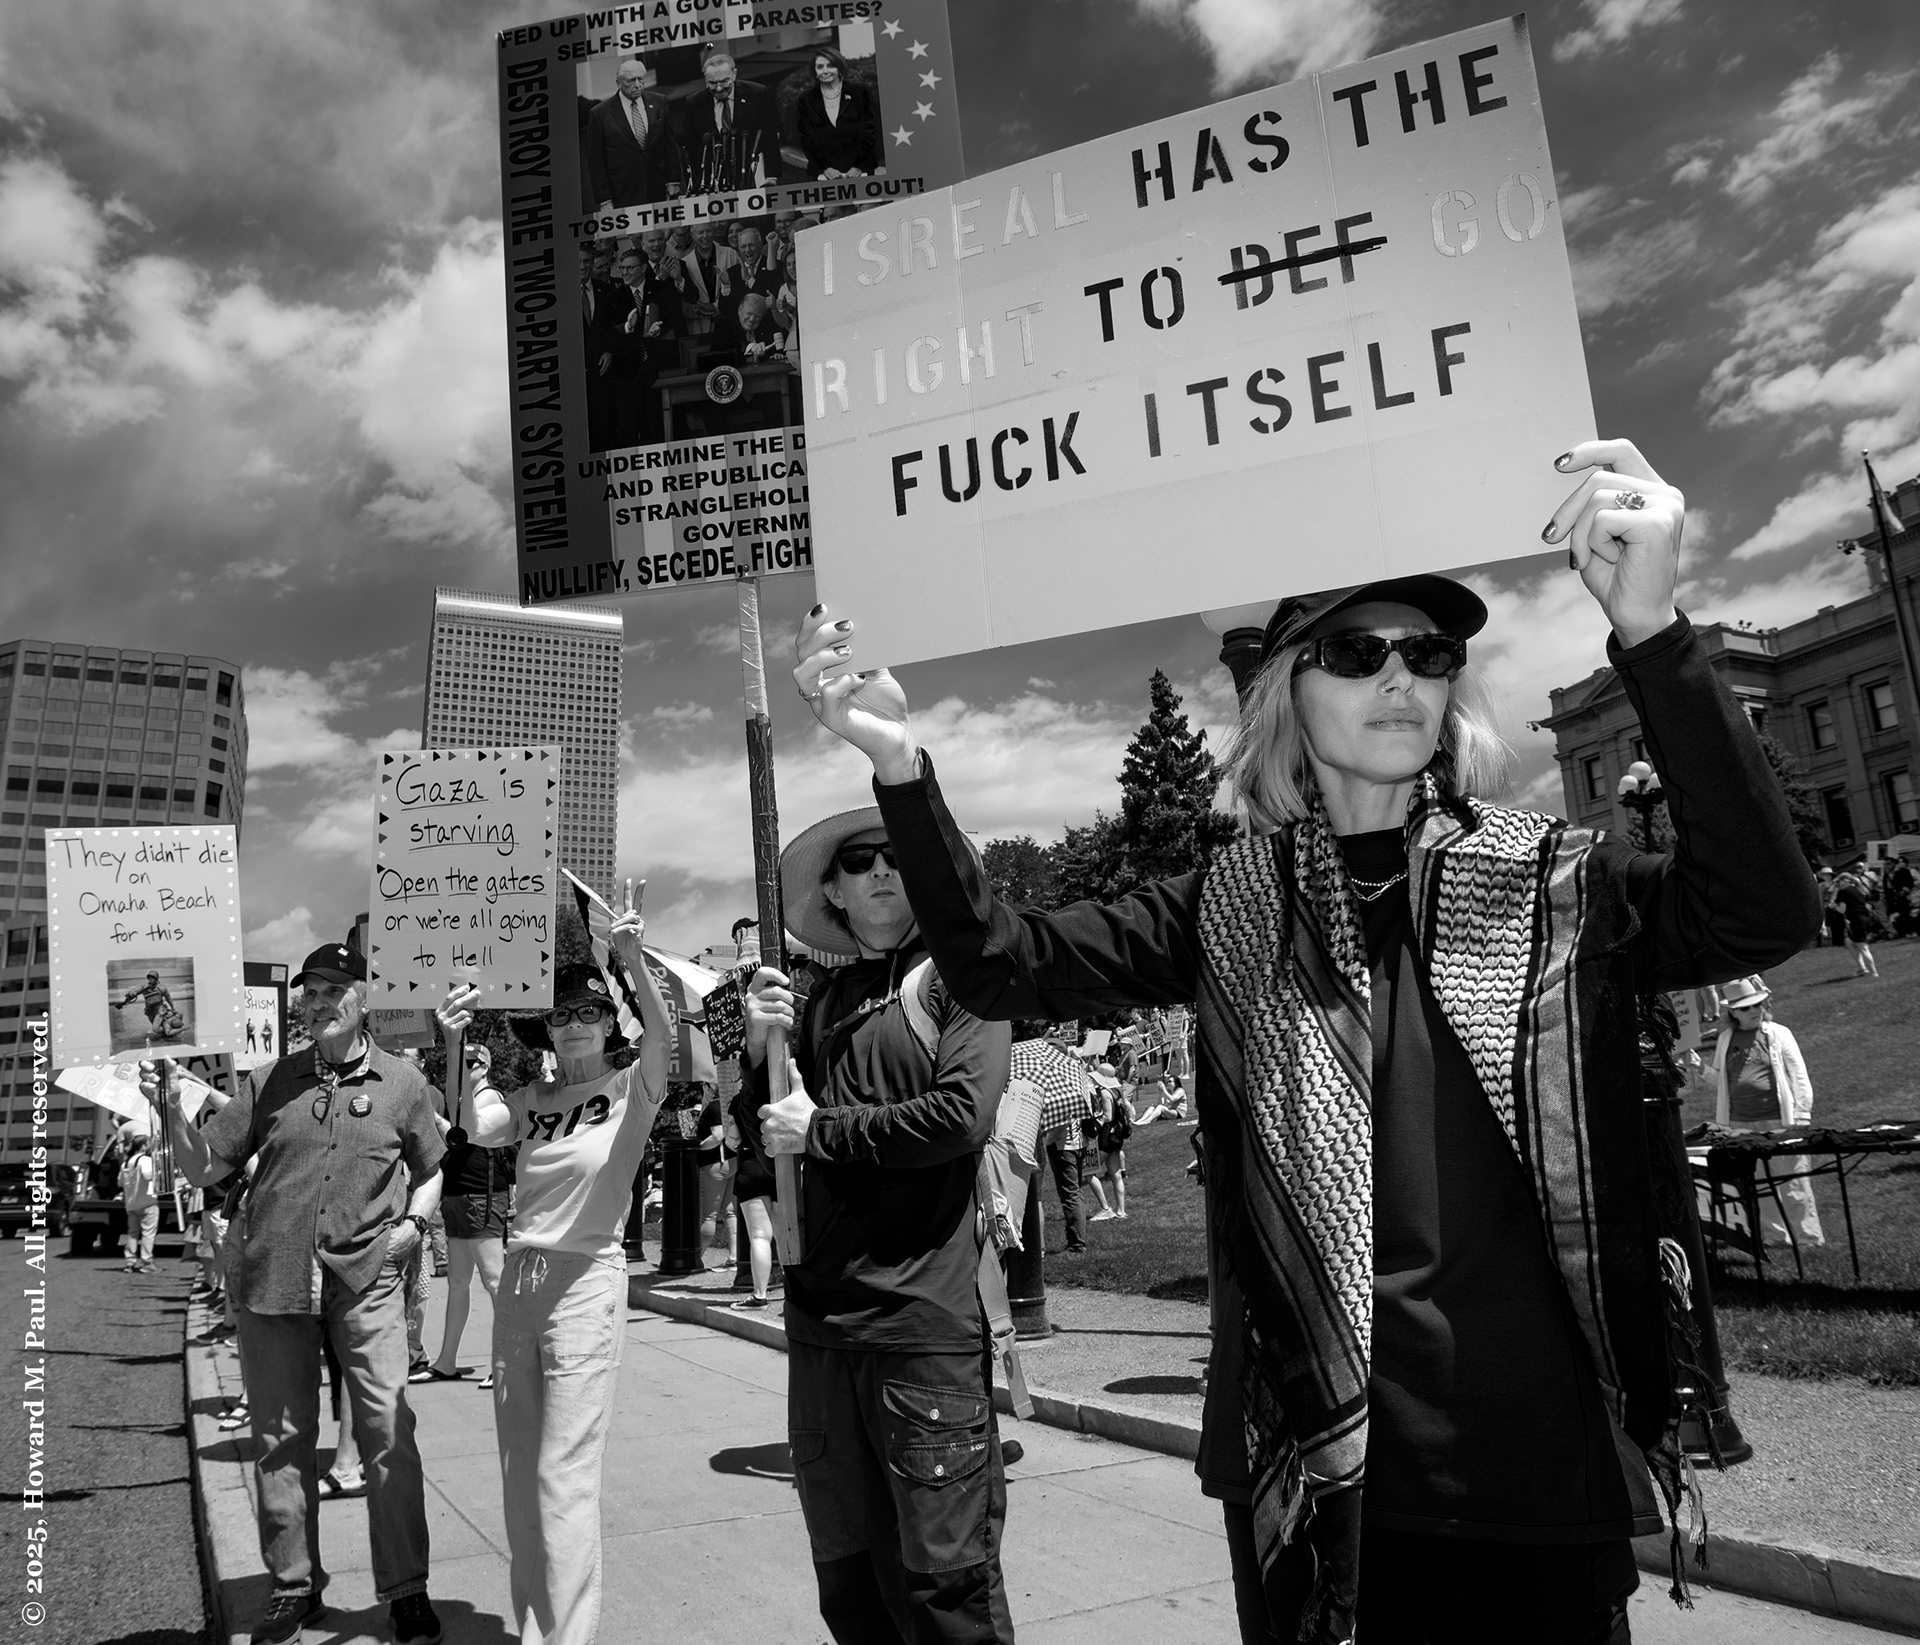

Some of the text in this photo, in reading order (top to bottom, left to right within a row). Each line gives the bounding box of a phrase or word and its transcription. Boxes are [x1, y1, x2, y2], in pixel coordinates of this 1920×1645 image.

[500, 25, 542, 49] FED
[550, 17, 580, 38] UP
[586, 4, 645, 30] WITH
[653, 1, 669, 18] A
[557, 0, 883, 61] SELF-SERVING PARASITES?
[821, 44, 1509, 296] ISREAL HAS THE
[568, 176, 925, 239] TOSS THE LOT OF THEM OUT!
[507, 57, 569, 553] DESTROY THE TWO-PARTY SYSTEM!
[811, 301, 1044, 420] RIGHT
[1084, 266, 1185, 343] TO
[1228, 211, 1374, 311] DEF
[1429, 172, 1549, 258] GO
[891, 321, 1471, 517] FUCK ITSELF
[578, 443, 726, 479] UNDERMINE
[733, 435, 785, 457] THE
[602, 459, 806, 502] AND REPUBLICA
[683, 512, 809, 543] GOVERNM
[523, 537, 812, 600] NULLIFY, SECEDE, FIGH
[396, 764, 525, 804] Gaza is
[410, 814, 515, 856] starving
[53, 837, 234, 884] They didn't die
[128, 871, 152, 885] on
[79, 886, 218, 916] Omaha Beach
[380, 866, 546, 905] Open the gates
[110, 922, 185, 944] for this
[385, 908, 548, 943] or we're all going
[413, 944, 494, 969] to Hell
